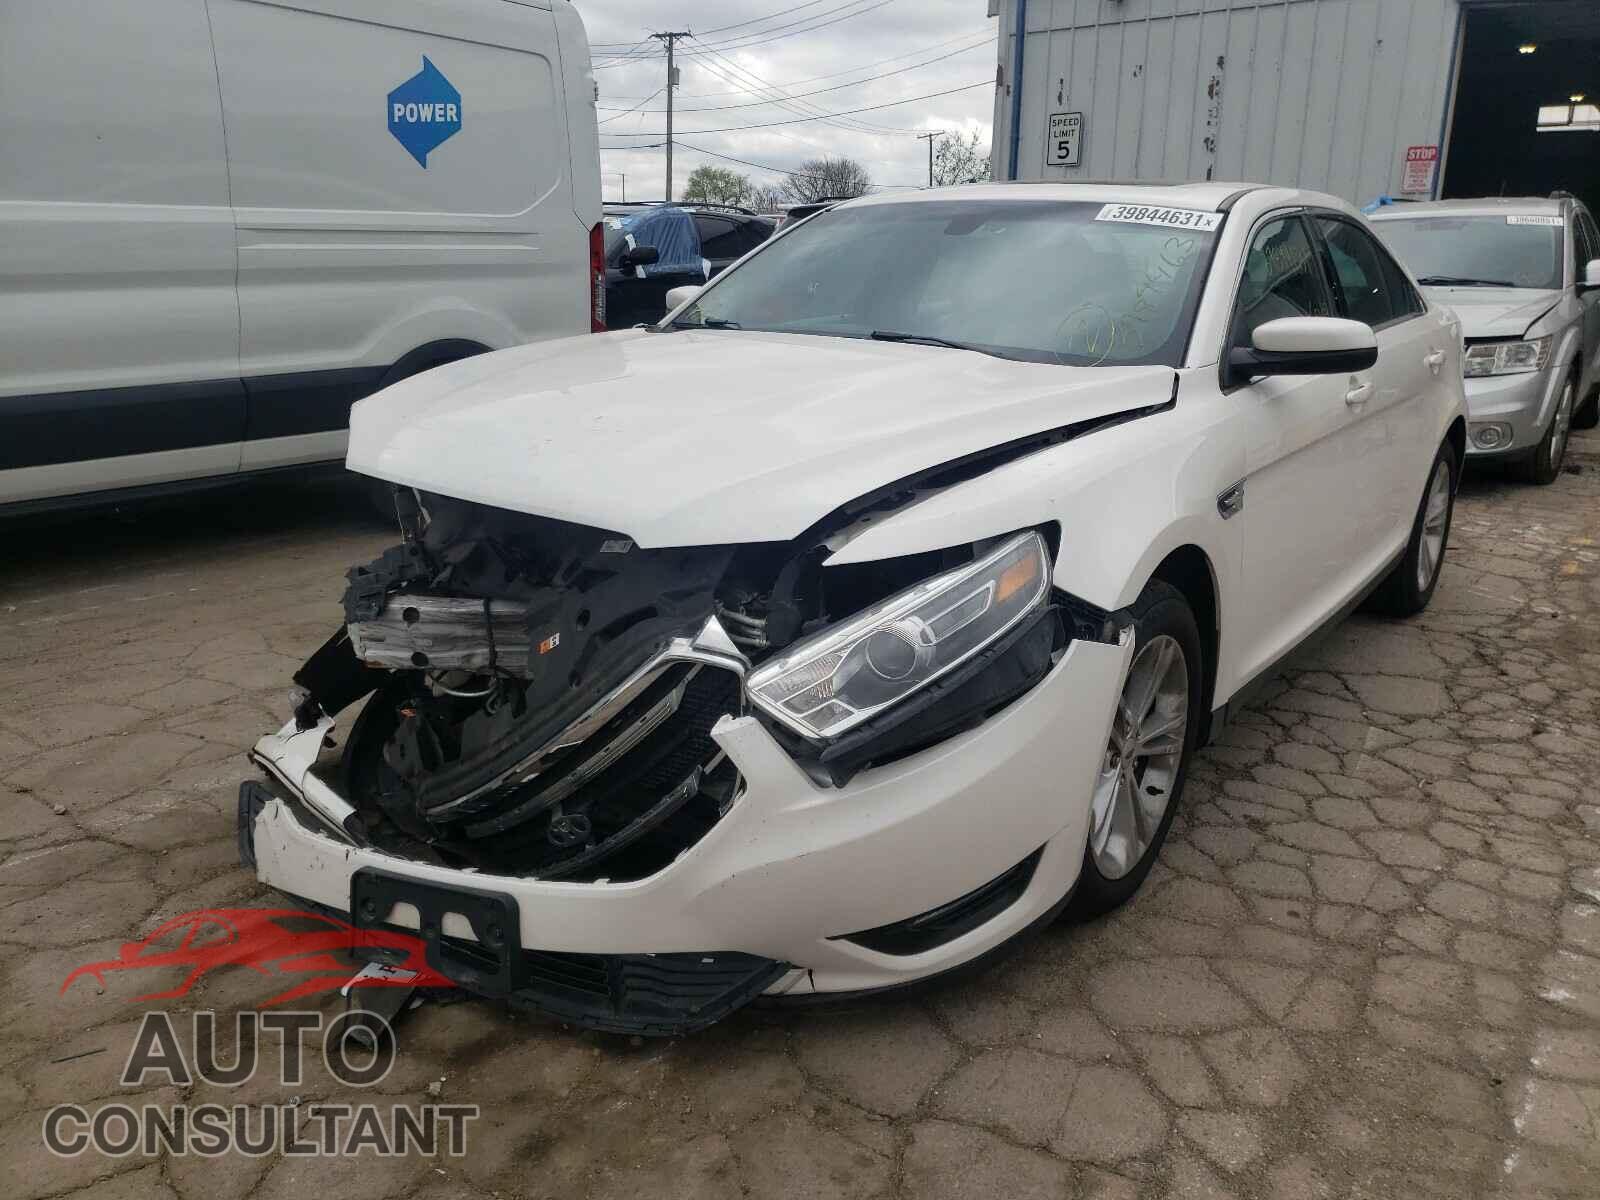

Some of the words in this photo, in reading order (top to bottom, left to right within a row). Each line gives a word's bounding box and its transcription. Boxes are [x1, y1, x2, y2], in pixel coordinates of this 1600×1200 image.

[393, 103, 459, 123] POWER
[1052, 118, 1079, 127] SPEED
[1053, 129, 1076, 138] LIMIT
[1057, 140, 1070, 159] 5
[1408, 148, 1436, 160] STOP
